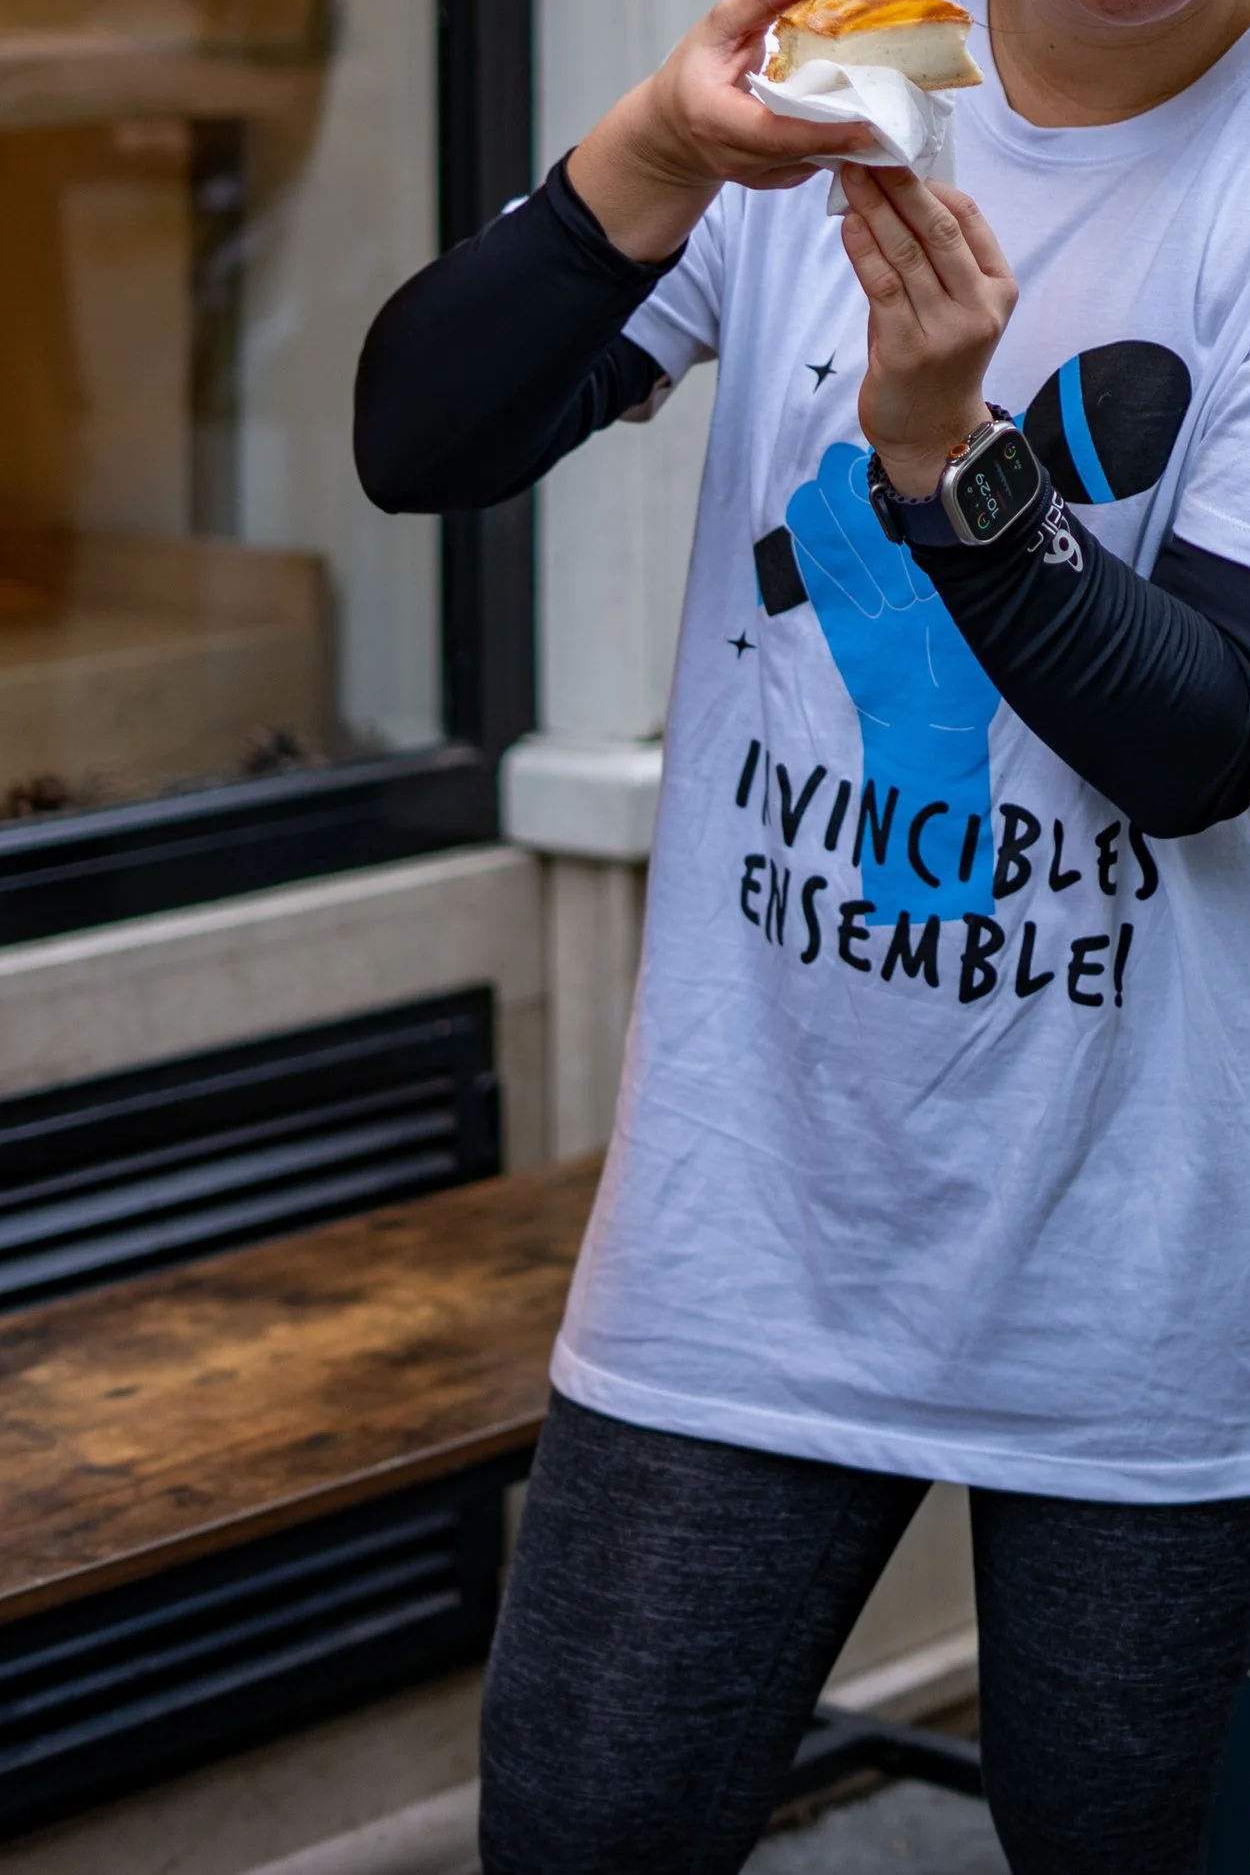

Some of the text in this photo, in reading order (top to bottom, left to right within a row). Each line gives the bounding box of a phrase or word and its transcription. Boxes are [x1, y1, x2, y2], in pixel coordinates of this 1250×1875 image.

[975, 473, 1000, 520] 10:29
[736, 739, 1159, 901] IVINCIBLES
[740, 854, 1134, 1008] ENSEMBLE!
